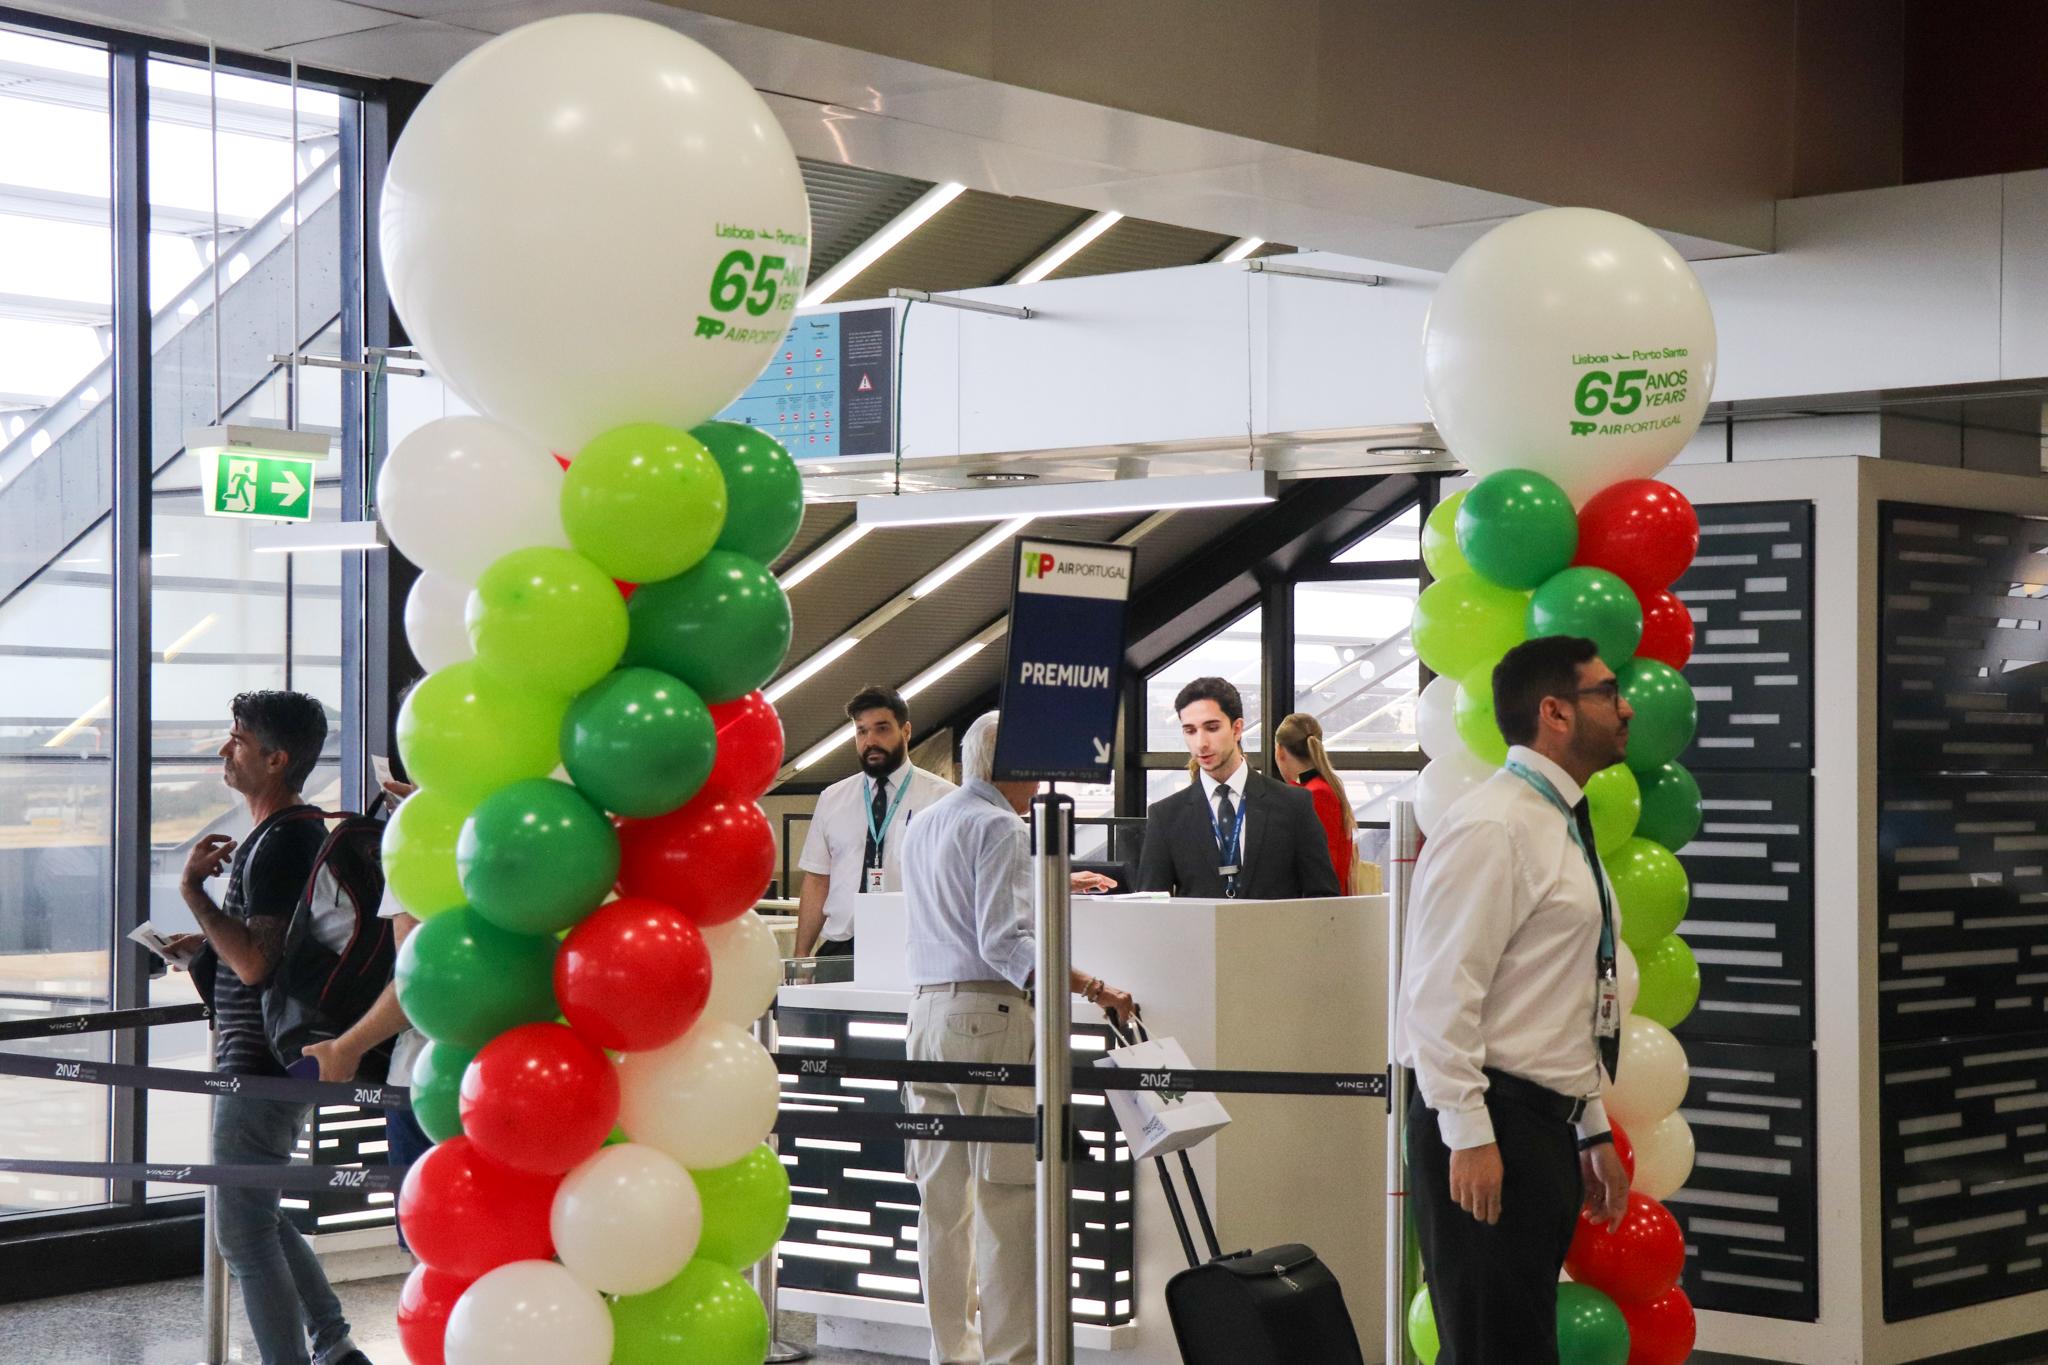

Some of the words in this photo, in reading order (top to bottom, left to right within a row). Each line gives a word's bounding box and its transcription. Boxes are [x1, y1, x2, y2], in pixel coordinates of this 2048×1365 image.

[710, 249, 786, 317] 65
[1572, 353, 1609, 365] Lisboa
[1632, 350, 1662, 361] Porto
[1662, 347, 1688, 358] Santo
[1574, 369, 1648, 417] 65
[1645, 369, 1688, 390] ANOS
[1645, 388, 1687, 407] YEARS
[1020, 662, 1110, 689] PREMIUM
[968, 1070, 996, 1078] VINCI
[204, 1080, 229, 1088] VINCI
[1336, 1081, 1368, 1089] VINCI
[895, 1122, 928, 1131] VINCI
